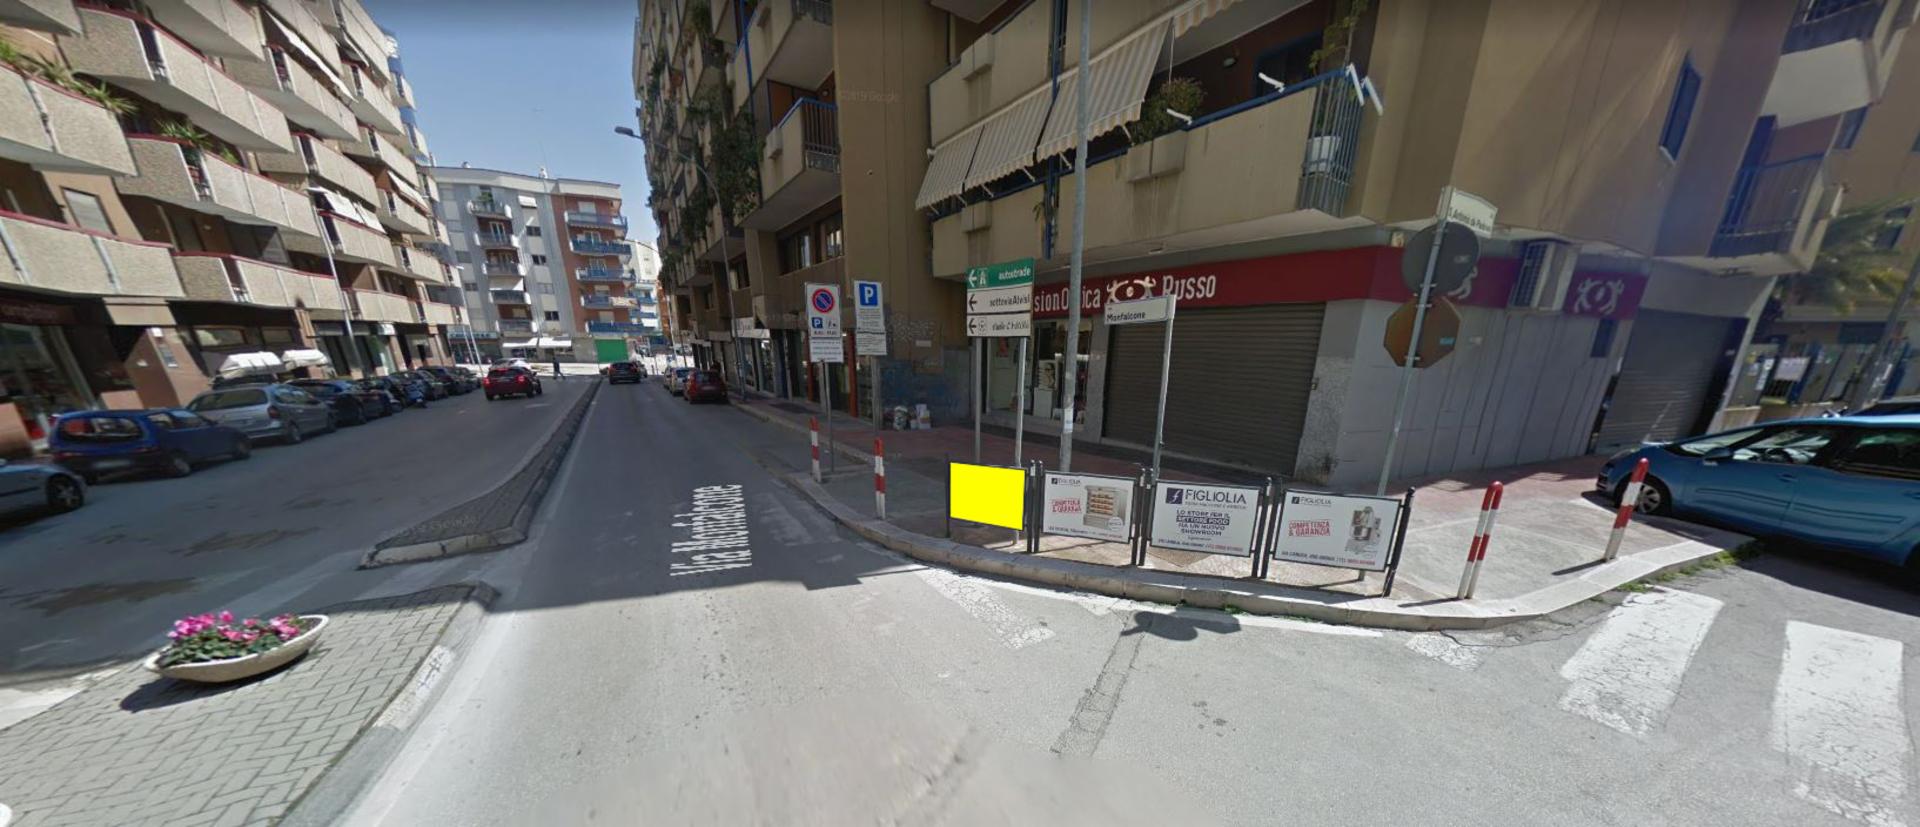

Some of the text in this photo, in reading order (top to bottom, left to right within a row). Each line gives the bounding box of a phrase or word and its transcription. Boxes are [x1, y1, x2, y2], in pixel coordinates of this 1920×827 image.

[864, 286, 874, 304] P
[1106, 311, 1146, 323] Monfalcone
[1184, 489, 1247, 505] FIGLIOLIA
